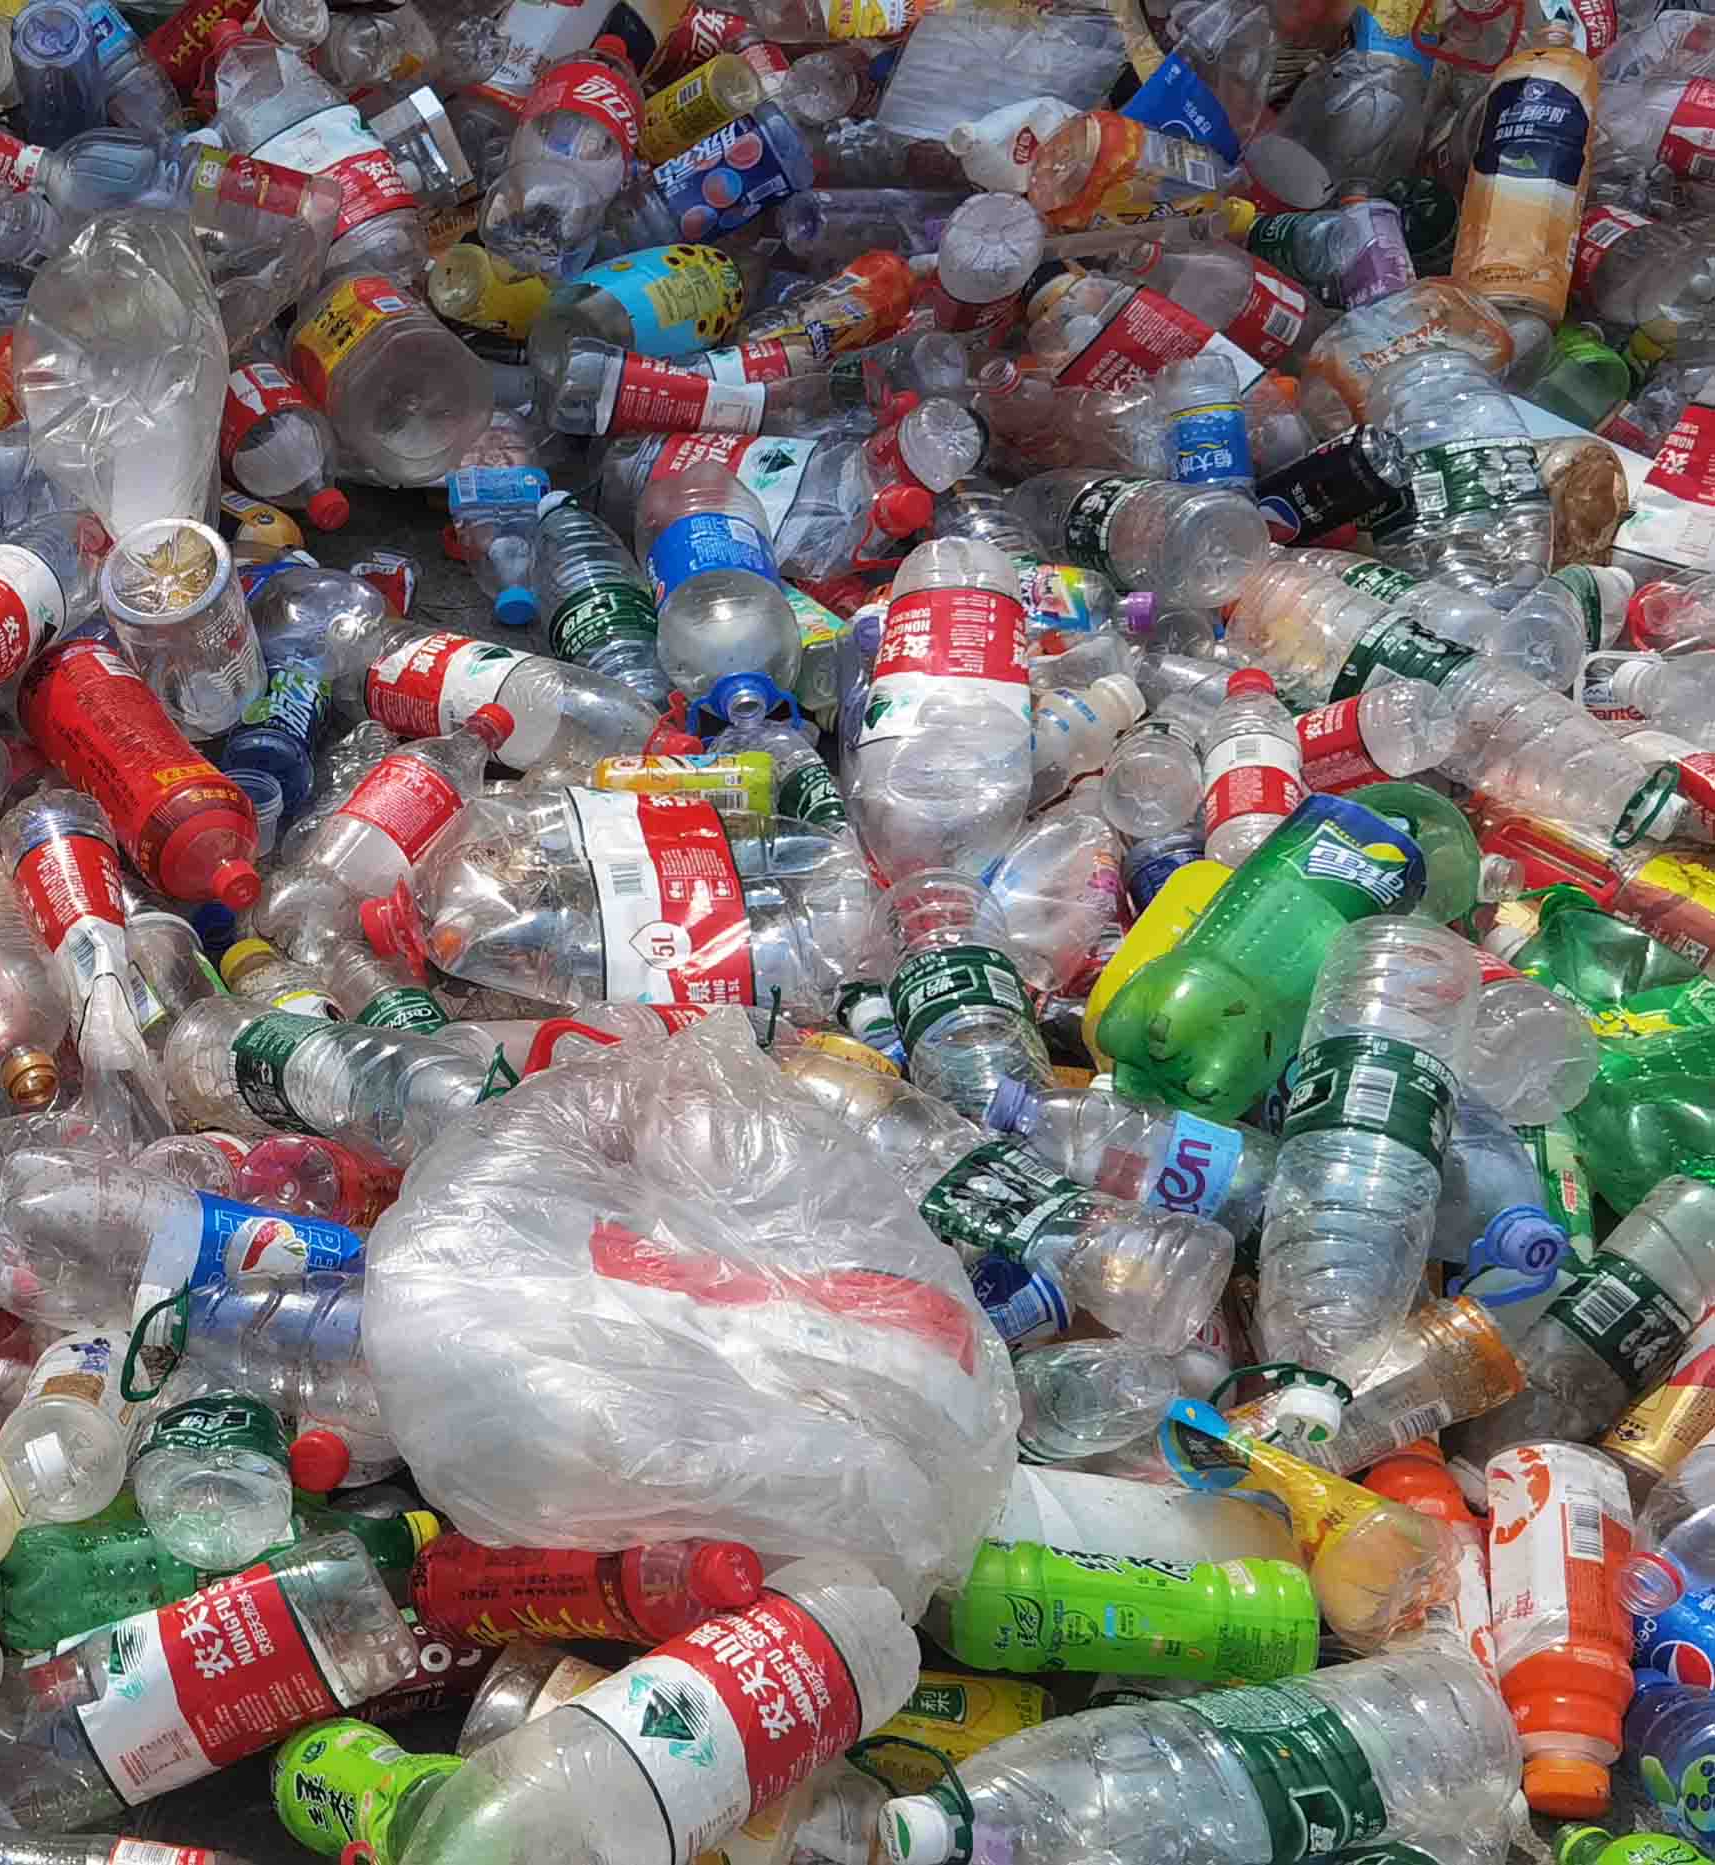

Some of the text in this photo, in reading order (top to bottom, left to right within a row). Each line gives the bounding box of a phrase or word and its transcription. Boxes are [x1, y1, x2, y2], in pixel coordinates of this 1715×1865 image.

[879, 633, 932, 662] 农夫
[1306, 843, 1404, 906] 雪碧
[652, 930, 676, 959] 5L
[222, 1597, 256, 1664] NONGFU
[236, 1590, 275, 1657] 饮用天然水
[696, 1619, 797, 1741] 农夫山泉
[767, 1647, 816, 1723] NONGFU
[788, 1640, 832, 1709] 饮用天然水
